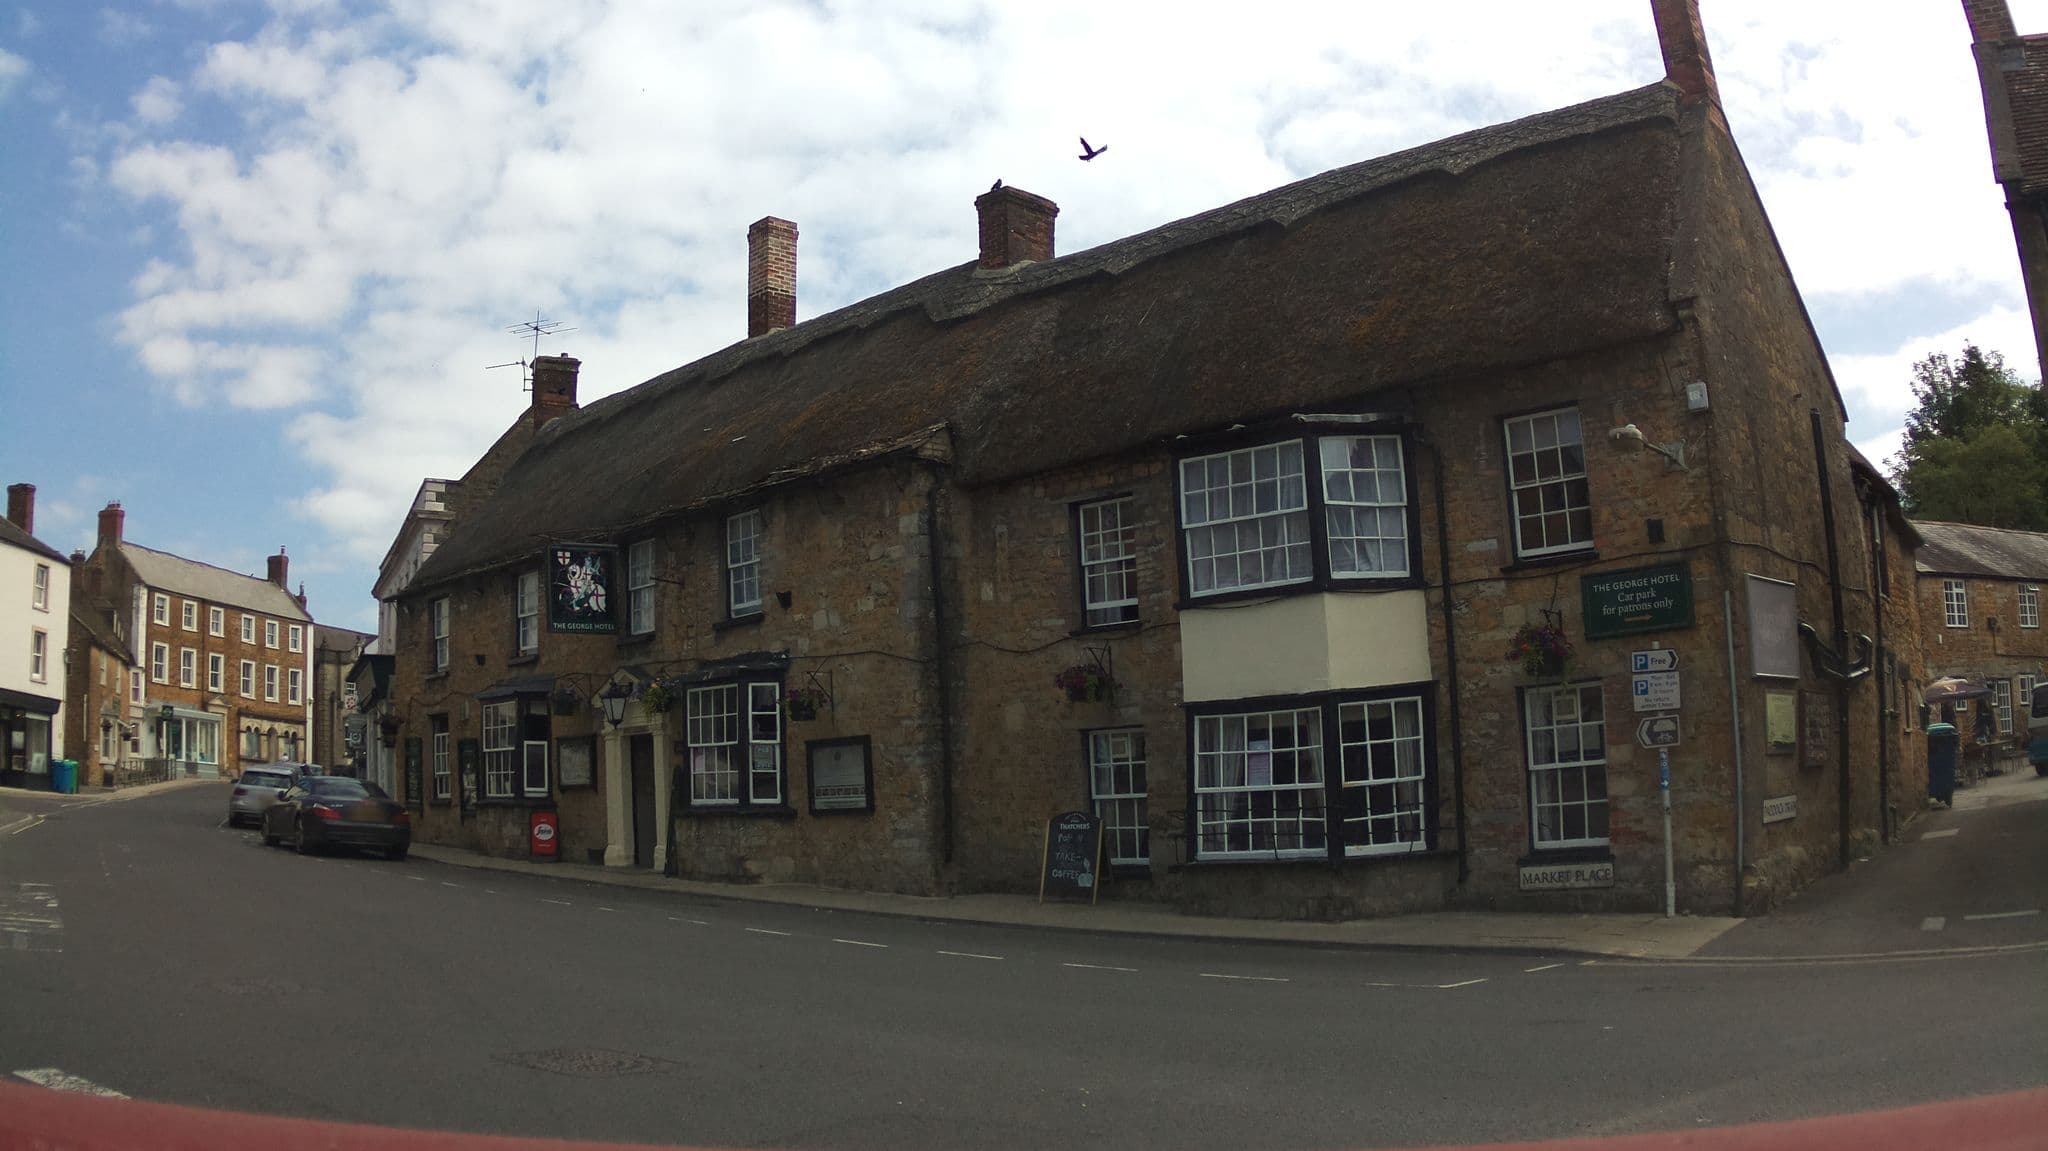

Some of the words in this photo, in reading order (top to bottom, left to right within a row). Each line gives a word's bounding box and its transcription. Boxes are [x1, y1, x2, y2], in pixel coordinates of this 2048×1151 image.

[1592, 583, 1611, 593] THE
[1612, 578, 1649, 591] GEORGE
[1650, 573, 1681, 585] HOTEL
[1617, 592, 1635, 602] Car
[1636, 587, 1657, 602] park
[1602, 604, 1617, 616] for
[1618, 601, 1653, 616] patrons
[1653, 596, 1674, 609] only
[552, 622, 566, 630] THE
[567, 622, 593, 630] GEORGE
[594, 623, 615, 631] HOTEL
[1650, 657, 1667, 665] Free
[1051, 868, 1081, 880] COFFEE
[1522, 871, 1570, 885] MARKET
[1575, 868, 1612, 882] PLACE
